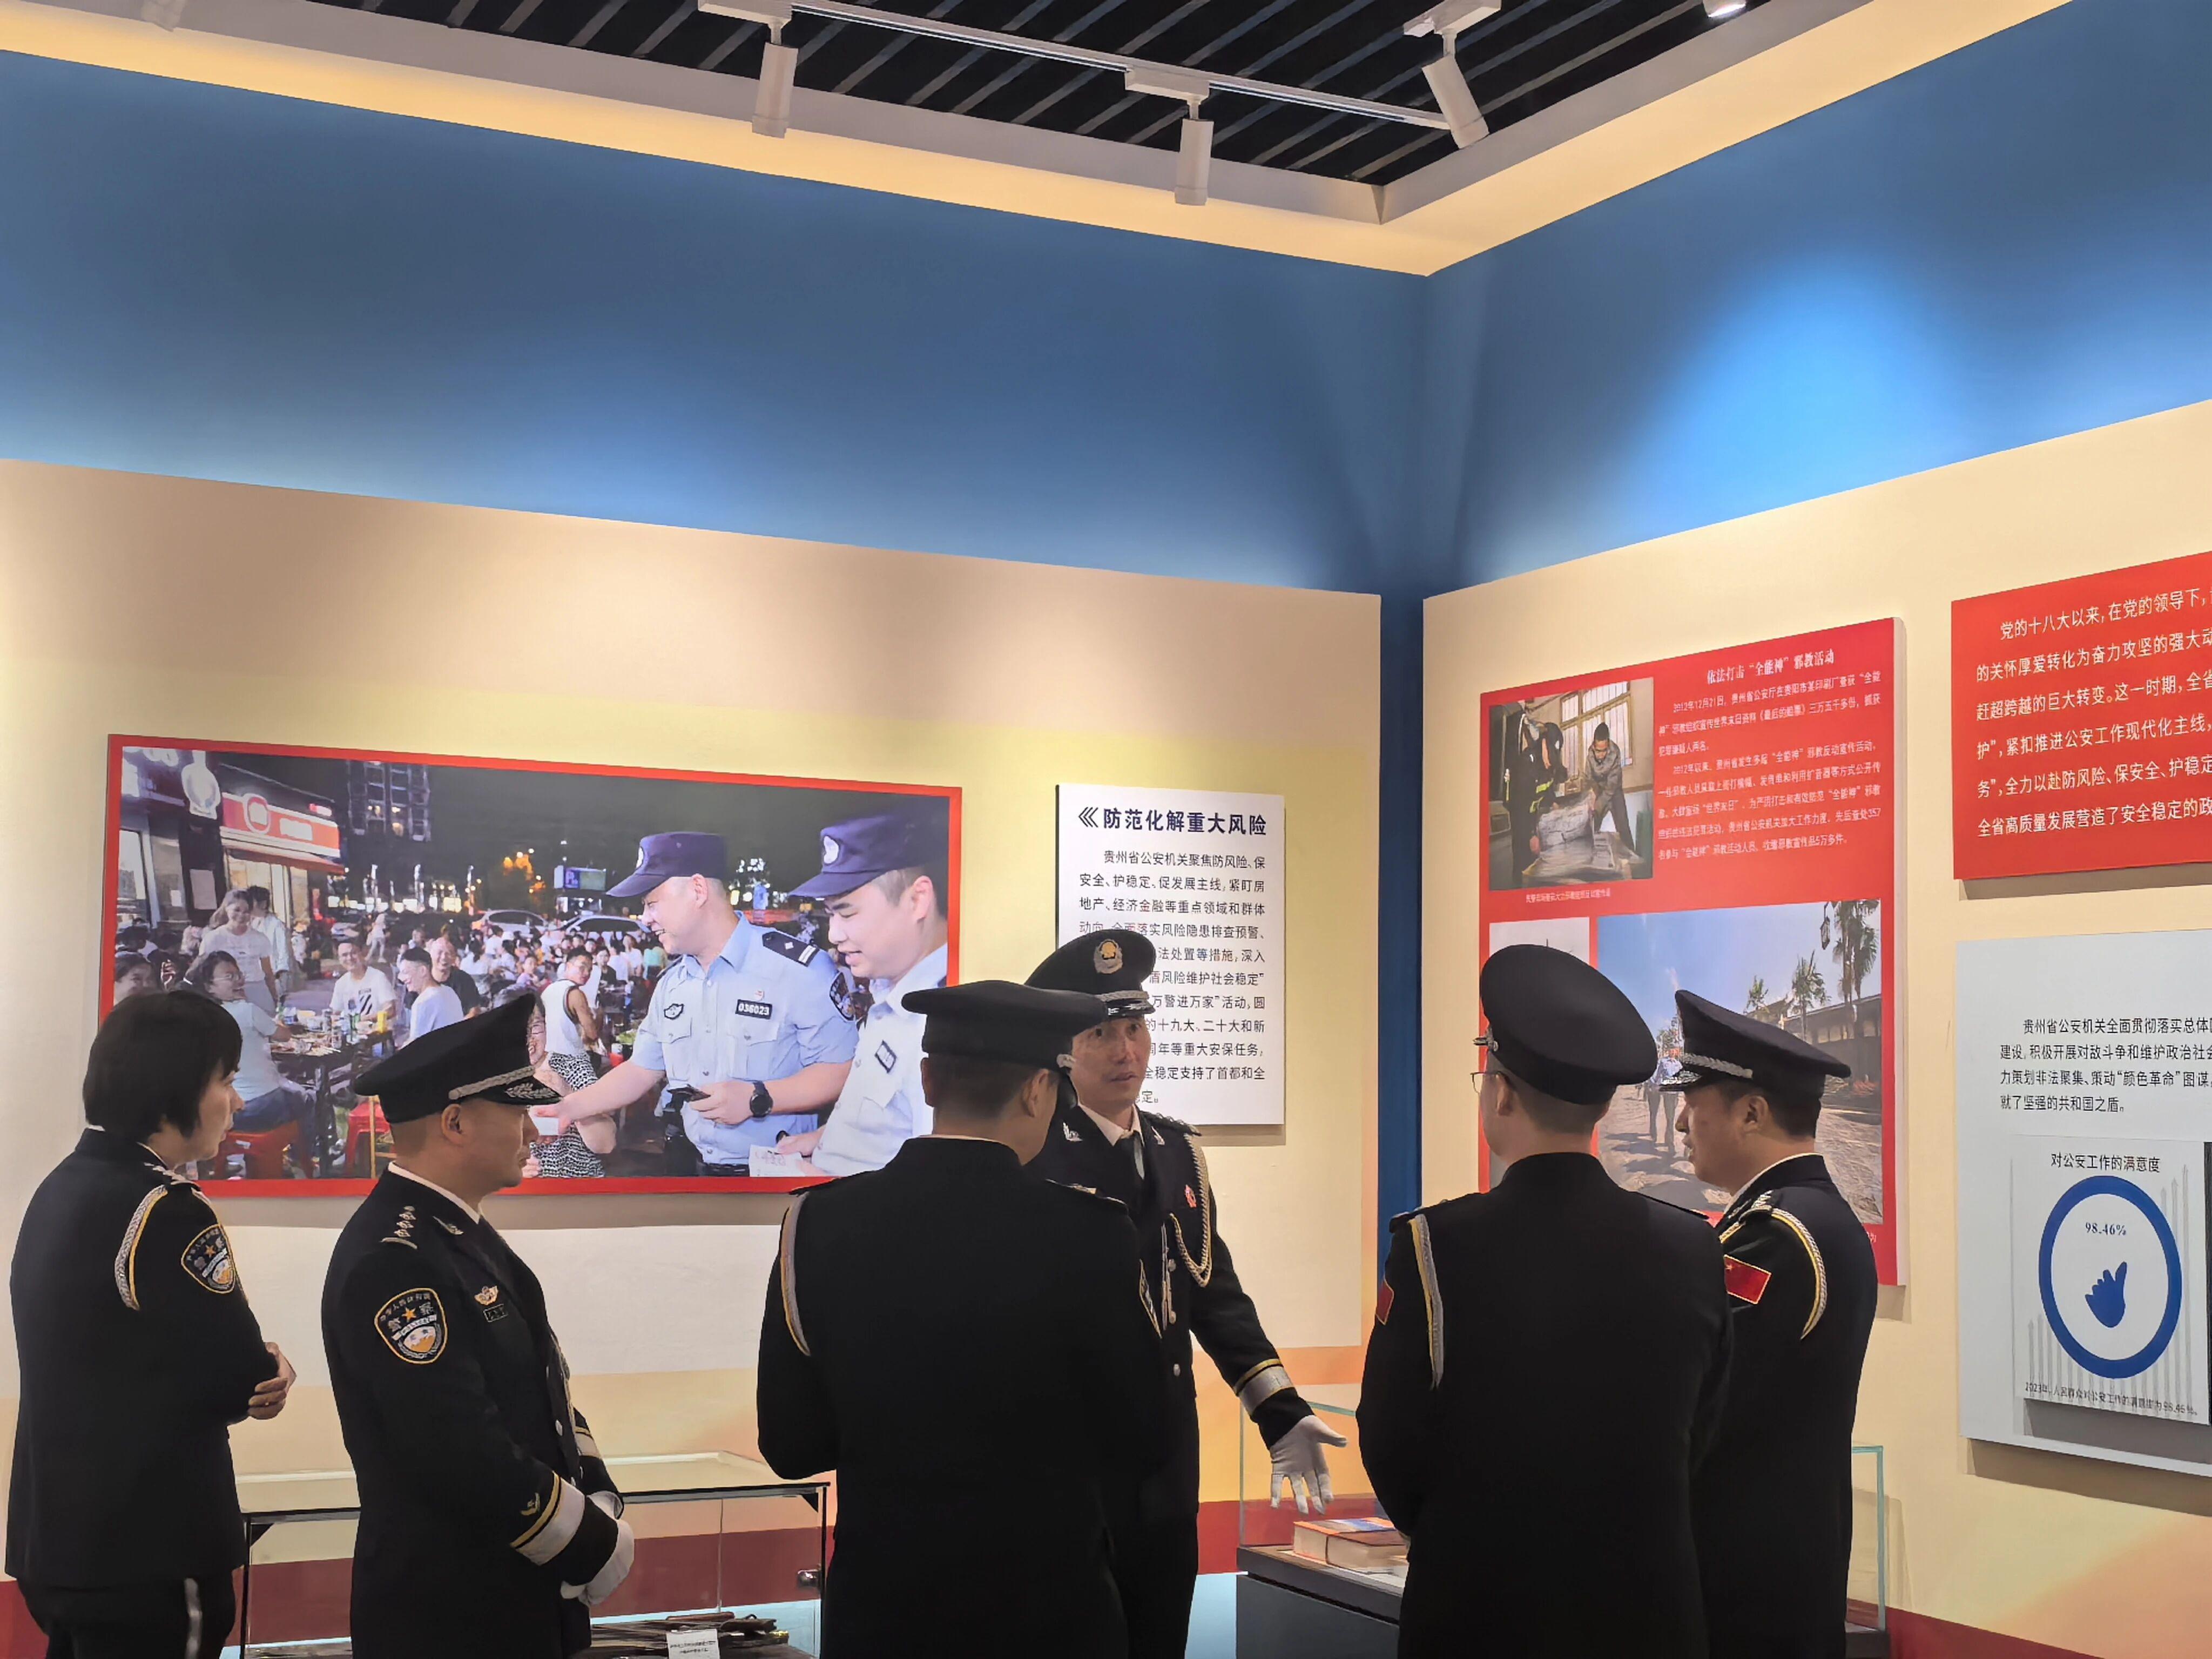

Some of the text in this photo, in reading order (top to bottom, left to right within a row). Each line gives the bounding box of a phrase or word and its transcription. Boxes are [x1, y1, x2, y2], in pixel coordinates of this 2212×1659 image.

[2000, 587, 2212, 640] 党的十八大以来，在党的领导下，
[1976, 627, 2212, 683] 的关怀厚爱转化为奋力攻坚的强大动
[1976, 669, 2212, 721] 赶超跨越的巨大转变。这一时期，全省
[1977, 713, 2211, 760] 护”，紧扣推进公安工作现代化主线，
[1977, 754, 2212, 799] 务”，全力以赴防风险、保安全、护稳定
[1103, 807, 1266, 835] 防范化解重大风险
[1977, 796, 2212, 837] 全省高质量发展营造了安全稳定的政
[1104, 850, 1266, 869] 贵州省公安机关聚焦防风险、保
[1080, 873, 1265, 892] 安全、护稳定、促发展主线，紧盯房
[1080, 896, 1265, 915] 地产、经济金融等重点领域和群体
[1080, 921, 1264, 939] 动向全面落实风险隐患排查预警、
[1158, 947, 1265, 963] 法处置等措施，深入
[2024, 1017, 2212, 1034] 贵州省公安机关全面贯彻落实总体
[1136, 1090, 1159, 1103] 定。
[2000, 1095, 2124, 1112] 就了坚强的共和国之盾。
[2051, 1151, 2161, 1172] 对公安工作的满意度
[2085, 1222, 2127, 1236] 98.46%
